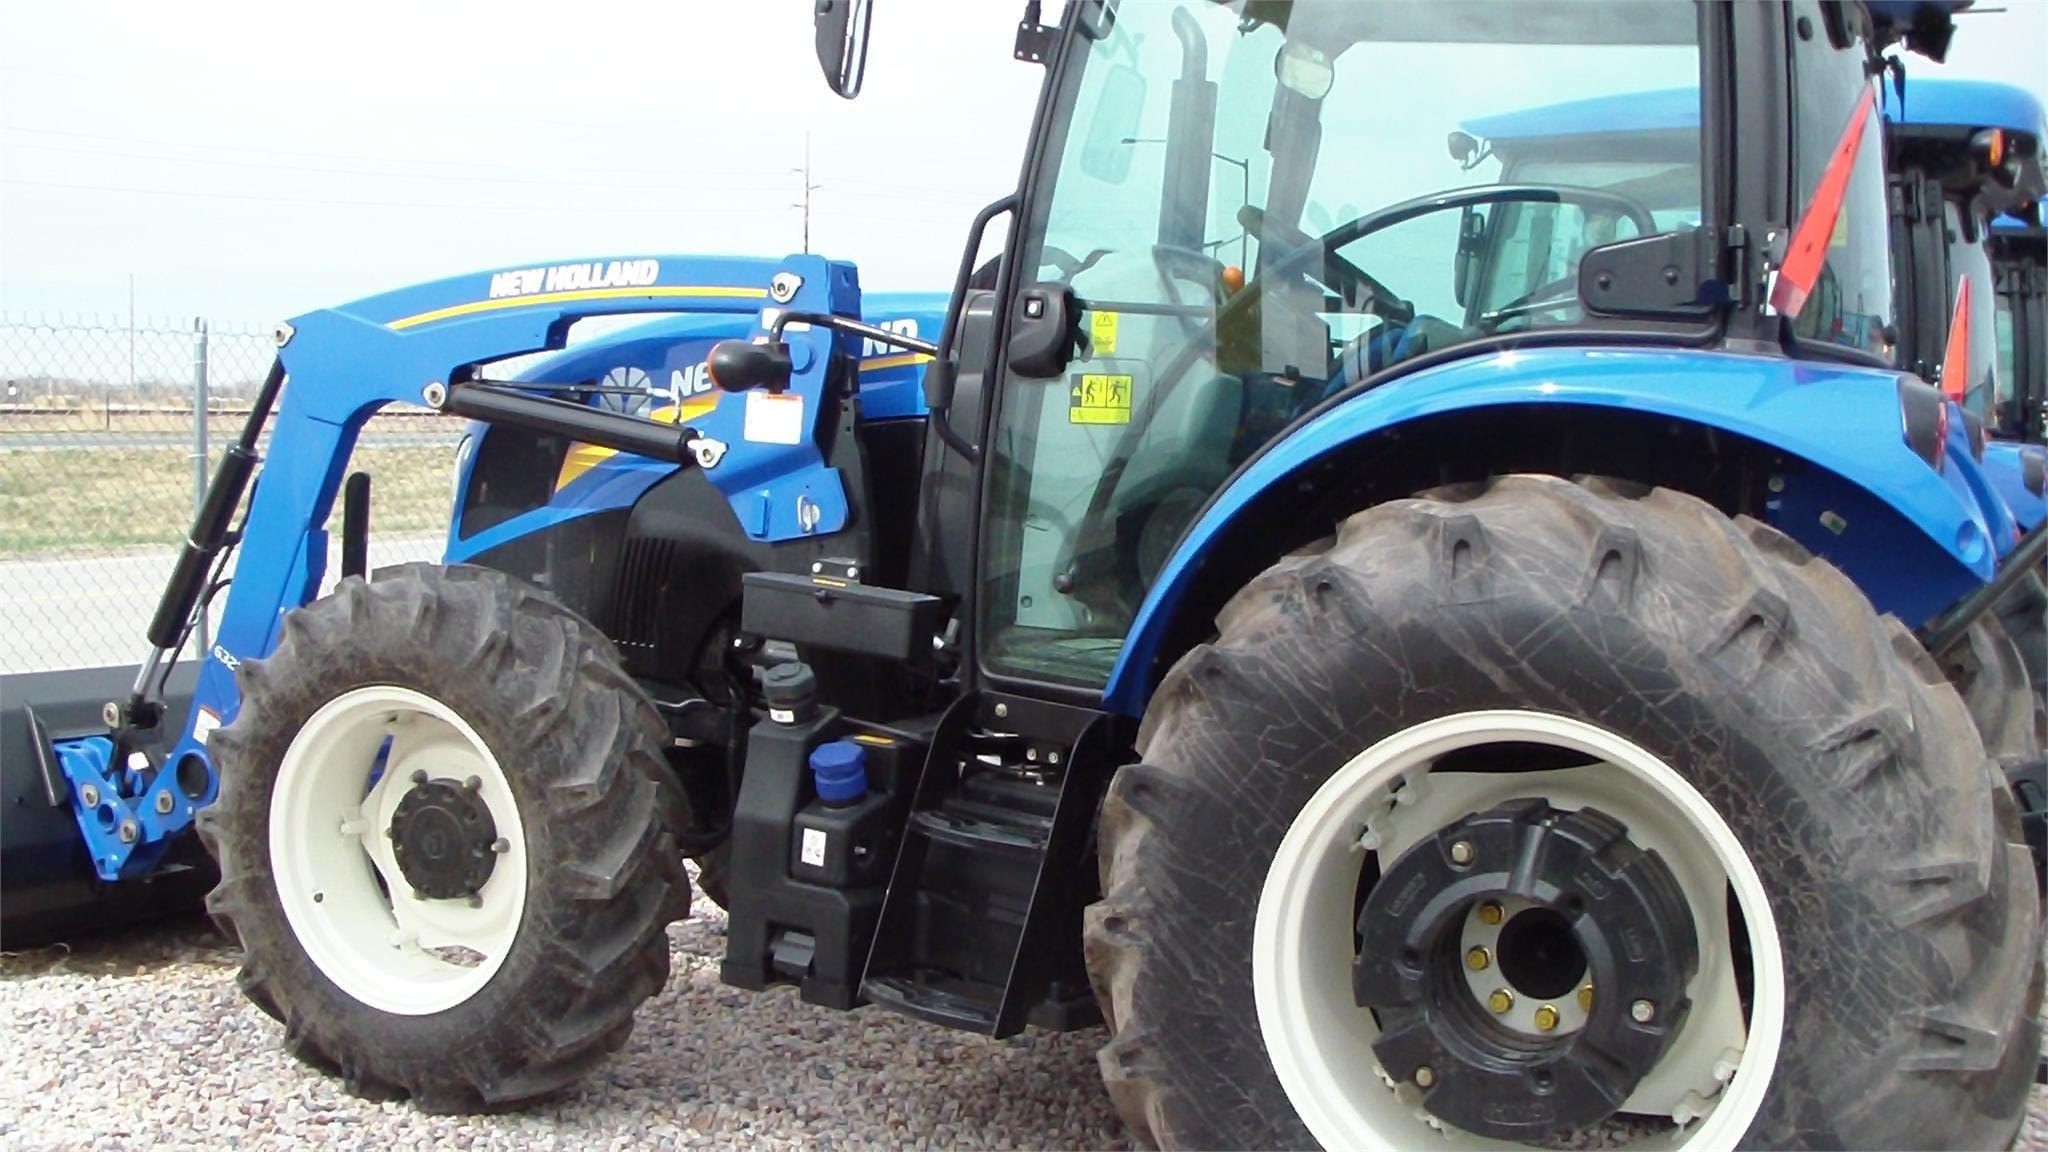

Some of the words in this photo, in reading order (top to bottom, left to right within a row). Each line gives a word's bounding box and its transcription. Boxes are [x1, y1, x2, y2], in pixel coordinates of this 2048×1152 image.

[489, 268, 546, 299] NEW
[545, 259, 660, 292] HOLLAND
[670, 361, 713, 397] NE
[862, 318, 919, 357] ND
[213, 644, 241, 671] 632
